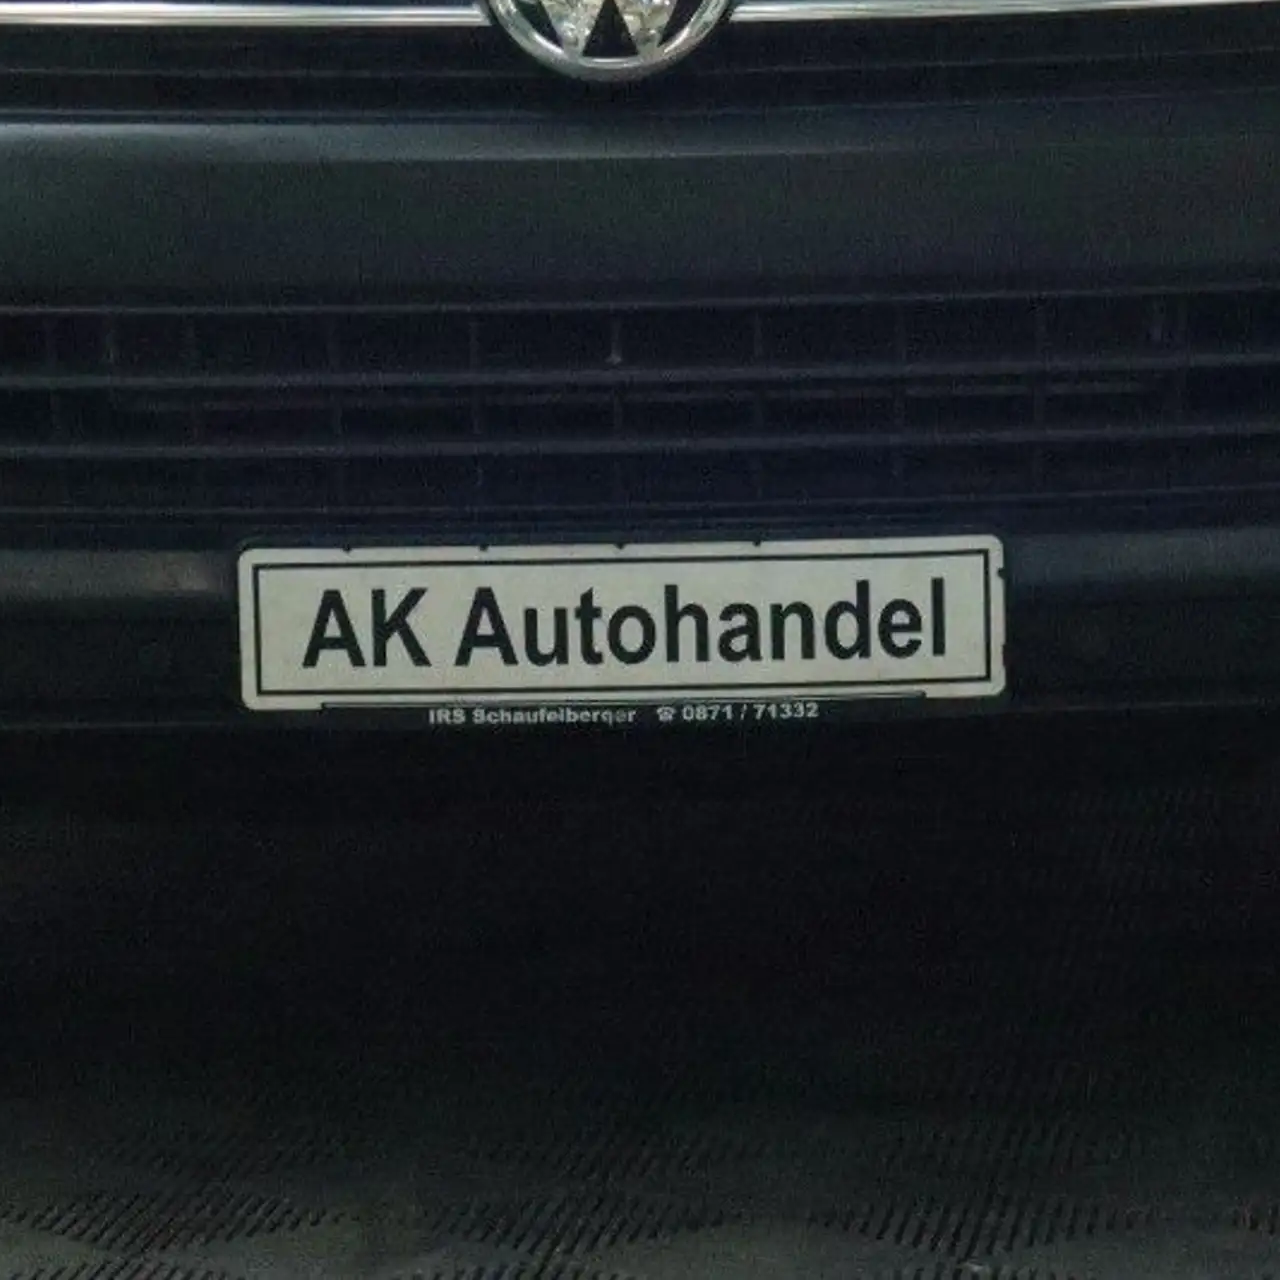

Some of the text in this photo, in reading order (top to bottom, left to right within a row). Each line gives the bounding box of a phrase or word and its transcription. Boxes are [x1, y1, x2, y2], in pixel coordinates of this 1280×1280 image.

[302, 577, 947, 669] AK Autohandel
[428, 708, 466, 725] IRS
[681, 703, 733, 721] 0871
[753, 701, 820, 719] 71332
